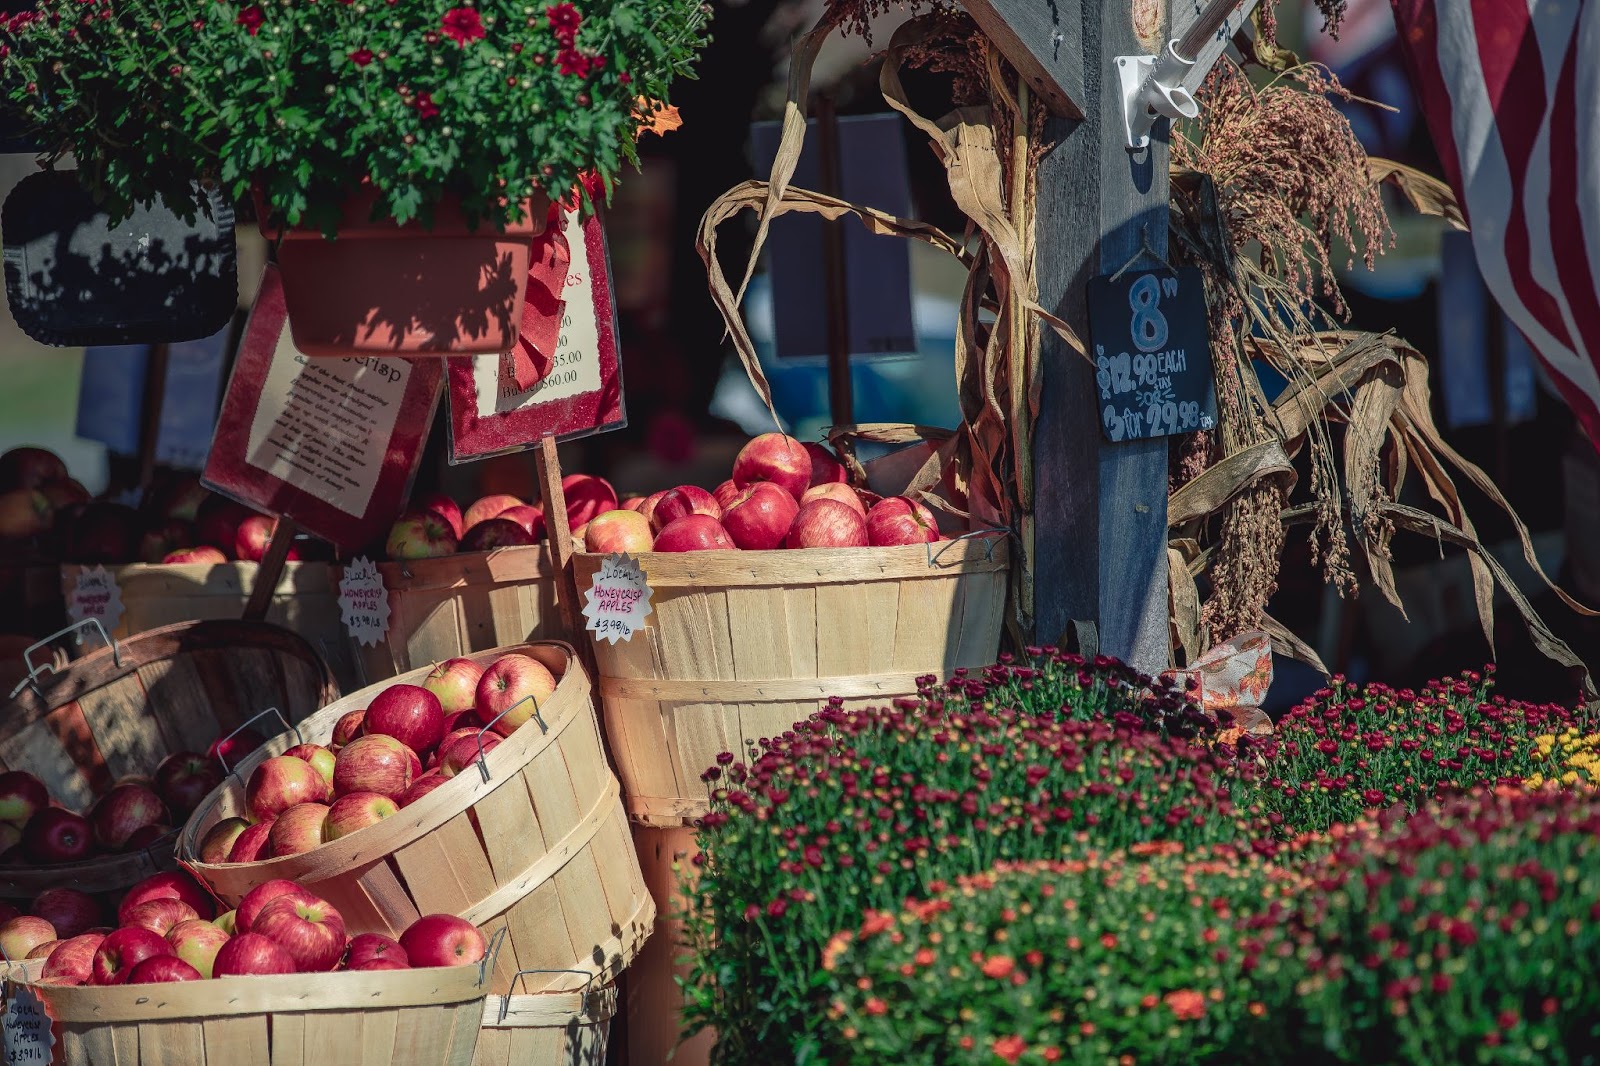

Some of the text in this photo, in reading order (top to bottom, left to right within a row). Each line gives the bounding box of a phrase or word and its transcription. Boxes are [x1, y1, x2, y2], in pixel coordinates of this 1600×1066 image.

[553, 350, 582, 368] 35.00
[1157, 349, 1187, 374] EACH
[542, 369, 578, 389] $60.00
[1103, 404, 1125, 442] 3
[1122, 407, 1144, 439] for
[1146, 401, 1199, 437] 29.98
[593, 585, 643, 602] HONEYCRISP
[598, 600, 634, 614] APPLES
